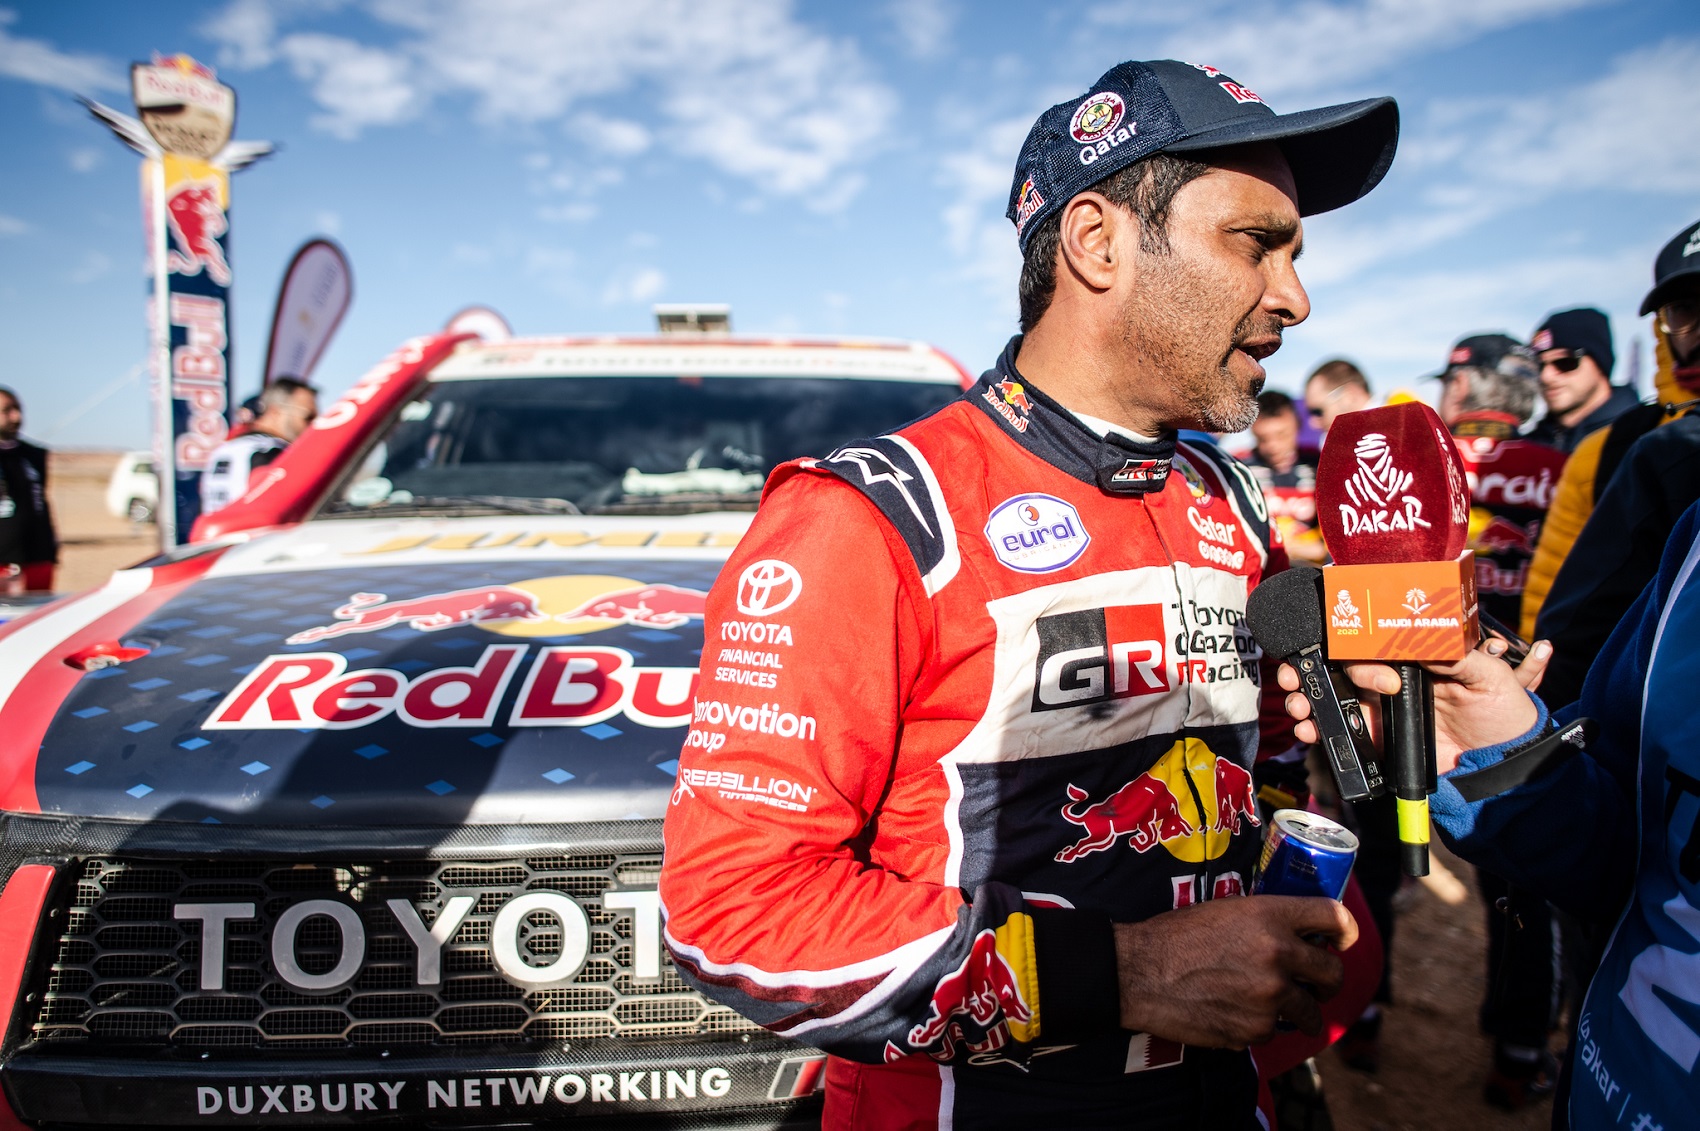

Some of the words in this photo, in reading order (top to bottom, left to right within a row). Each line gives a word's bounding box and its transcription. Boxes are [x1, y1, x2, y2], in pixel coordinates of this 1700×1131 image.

[1219, 82, 1264, 104] Re
[1080, 122, 1137, 165] Qatar
[1024, 188, 1045, 222] Bull
[170, 292, 228, 381] Bull
[173, 382, 229, 471] Red
[982, 385, 1008, 413] Red
[1001, 404, 1030, 433] Bull
[1187, 506, 1236, 547] Qatar
[1339, 495, 1432, 536] DAKAR
[1001, 516, 1077, 552] eurol
[1188, 599, 1246, 629] TOYOT
[1331, 616, 1363, 629] DAKAR
[1378, 618, 1412, 629] SAUDI
[1414, 617, 1460, 628] ARABIA
[721, 621, 793, 646] TOYOTA
[1336, 628, 1359, 636] 2020
[718, 649, 783, 669] FINANCIAL
[1038, 640, 1166, 706] GR
[202, 644, 529, 730] Red
[508, 646, 699, 727] Bu
[715, 667, 777, 689] SERVICES
[684, 729, 726, 753] roup
[683, 768, 813, 802] REBELLION
[173, 890, 662, 993] TOYOT
[197, 1081, 406, 1115] DUXBURY
[427, 1067, 732, 1108] NETWORKING
